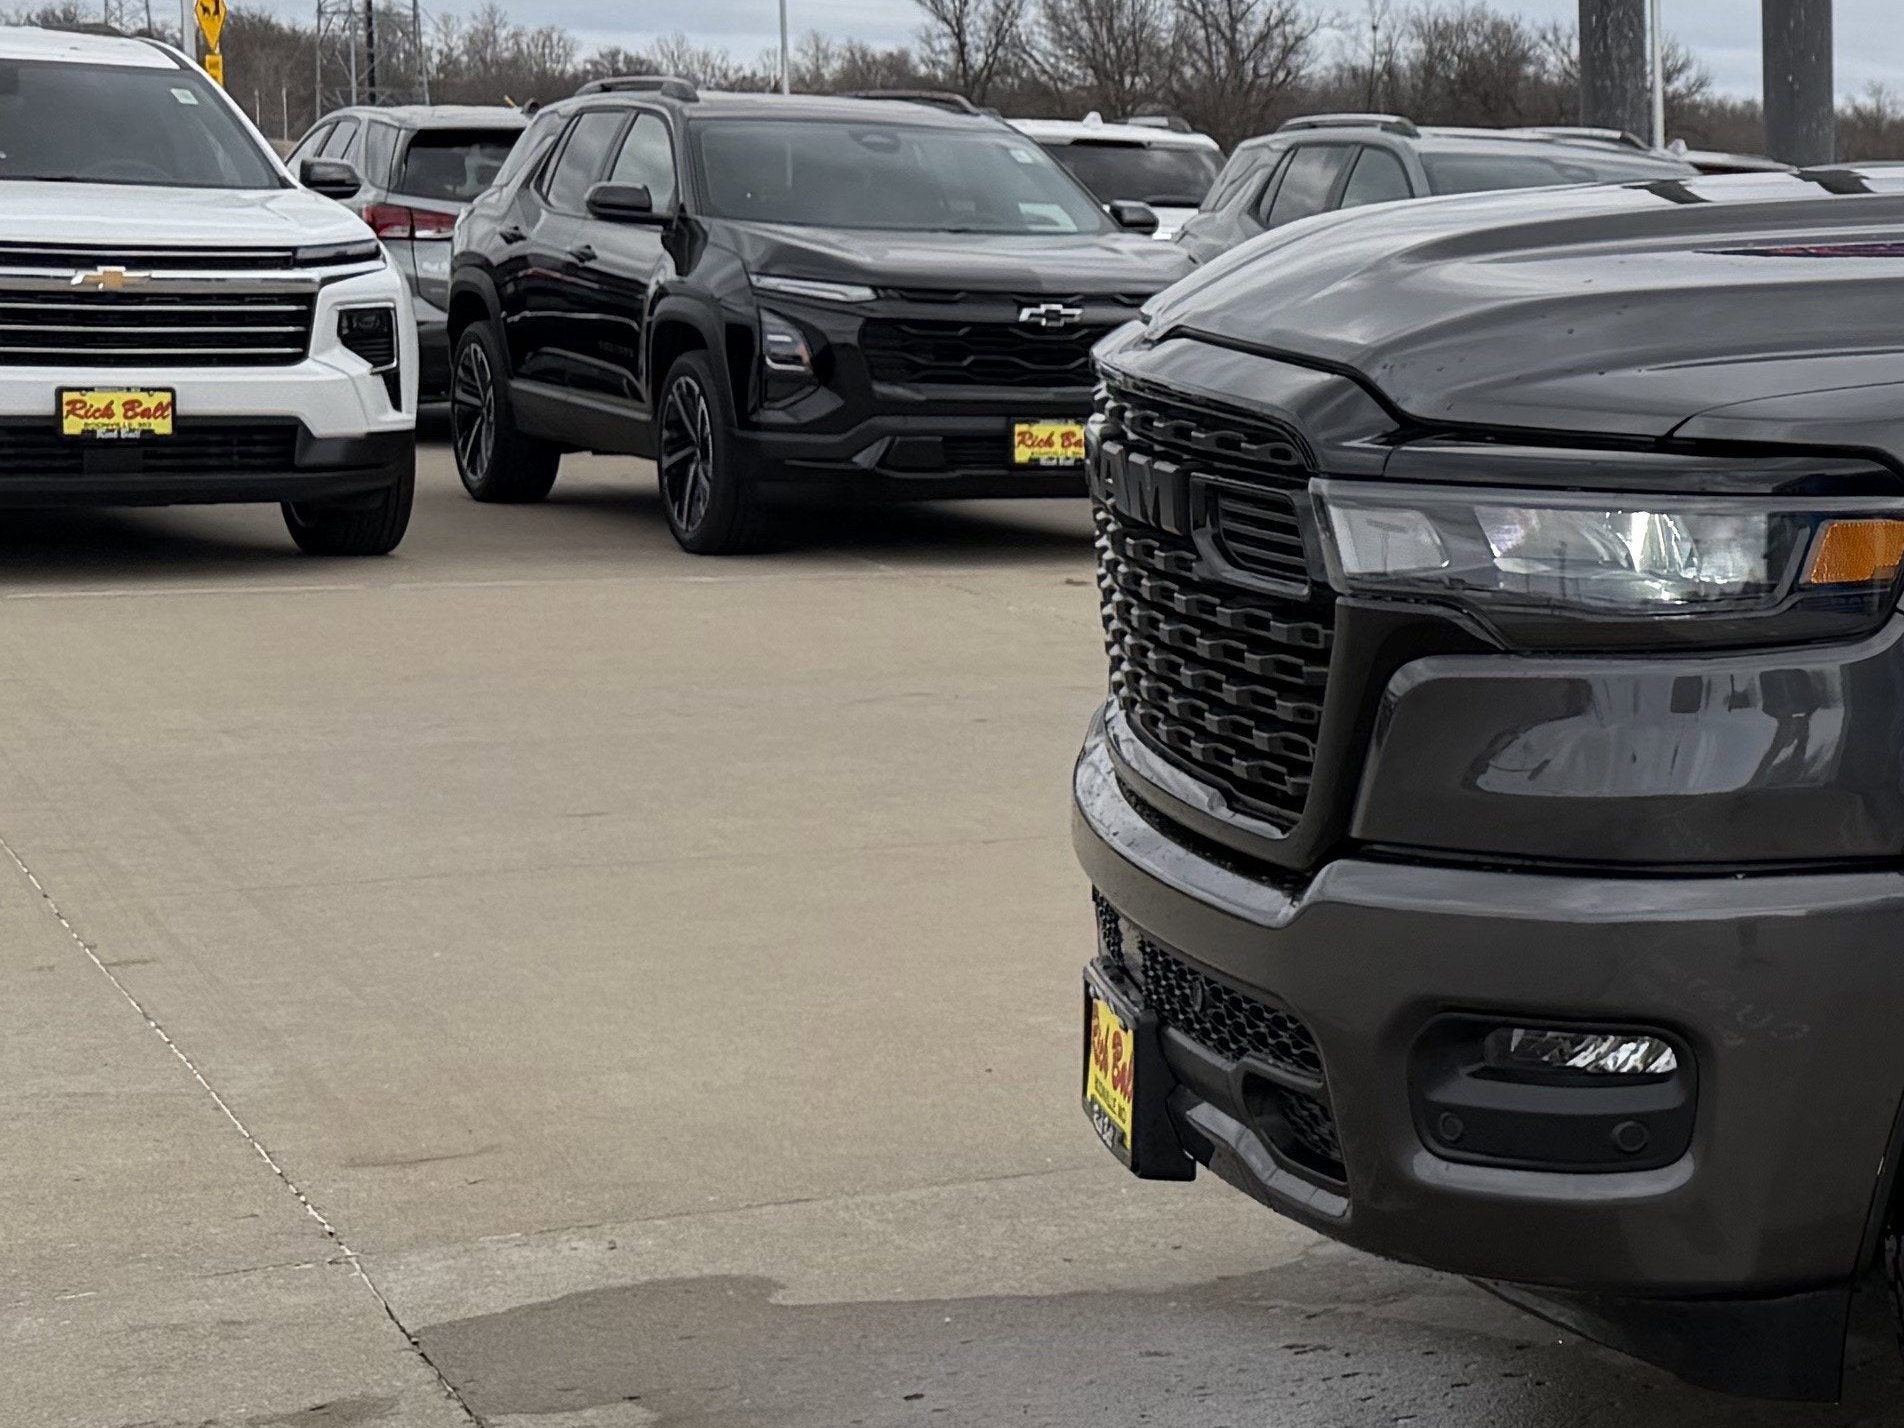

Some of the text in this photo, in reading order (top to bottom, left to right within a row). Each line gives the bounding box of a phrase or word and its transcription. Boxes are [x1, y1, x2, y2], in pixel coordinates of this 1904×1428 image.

[64, 398, 172, 420] Rick Ball
[1017, 430, 1084, 448] Rick Ba
[1092, 1002, 1110, 1080] Rick
[1111, 1030, 1134, 1104] Ball
